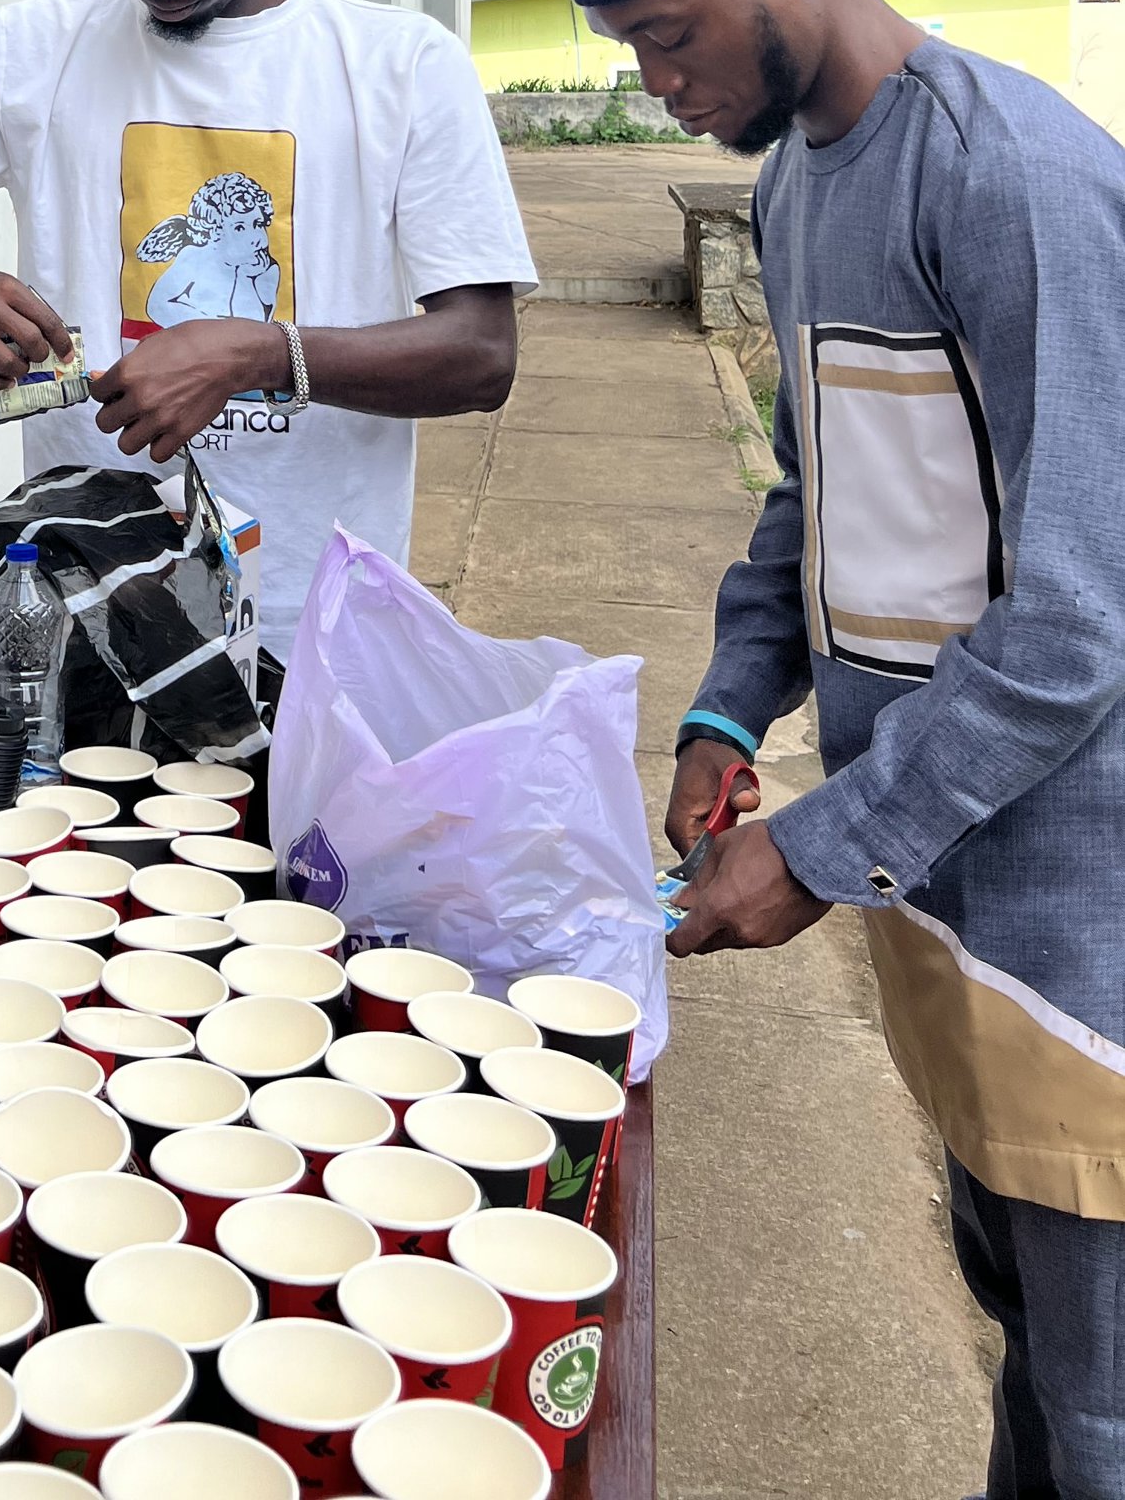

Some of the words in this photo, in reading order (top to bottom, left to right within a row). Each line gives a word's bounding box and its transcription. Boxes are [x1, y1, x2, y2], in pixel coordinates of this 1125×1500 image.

[208, 408, 290, 433] anca
[188, 432, 233, 451] ORT
[537, 1333, 582, 1372] COFFEE
